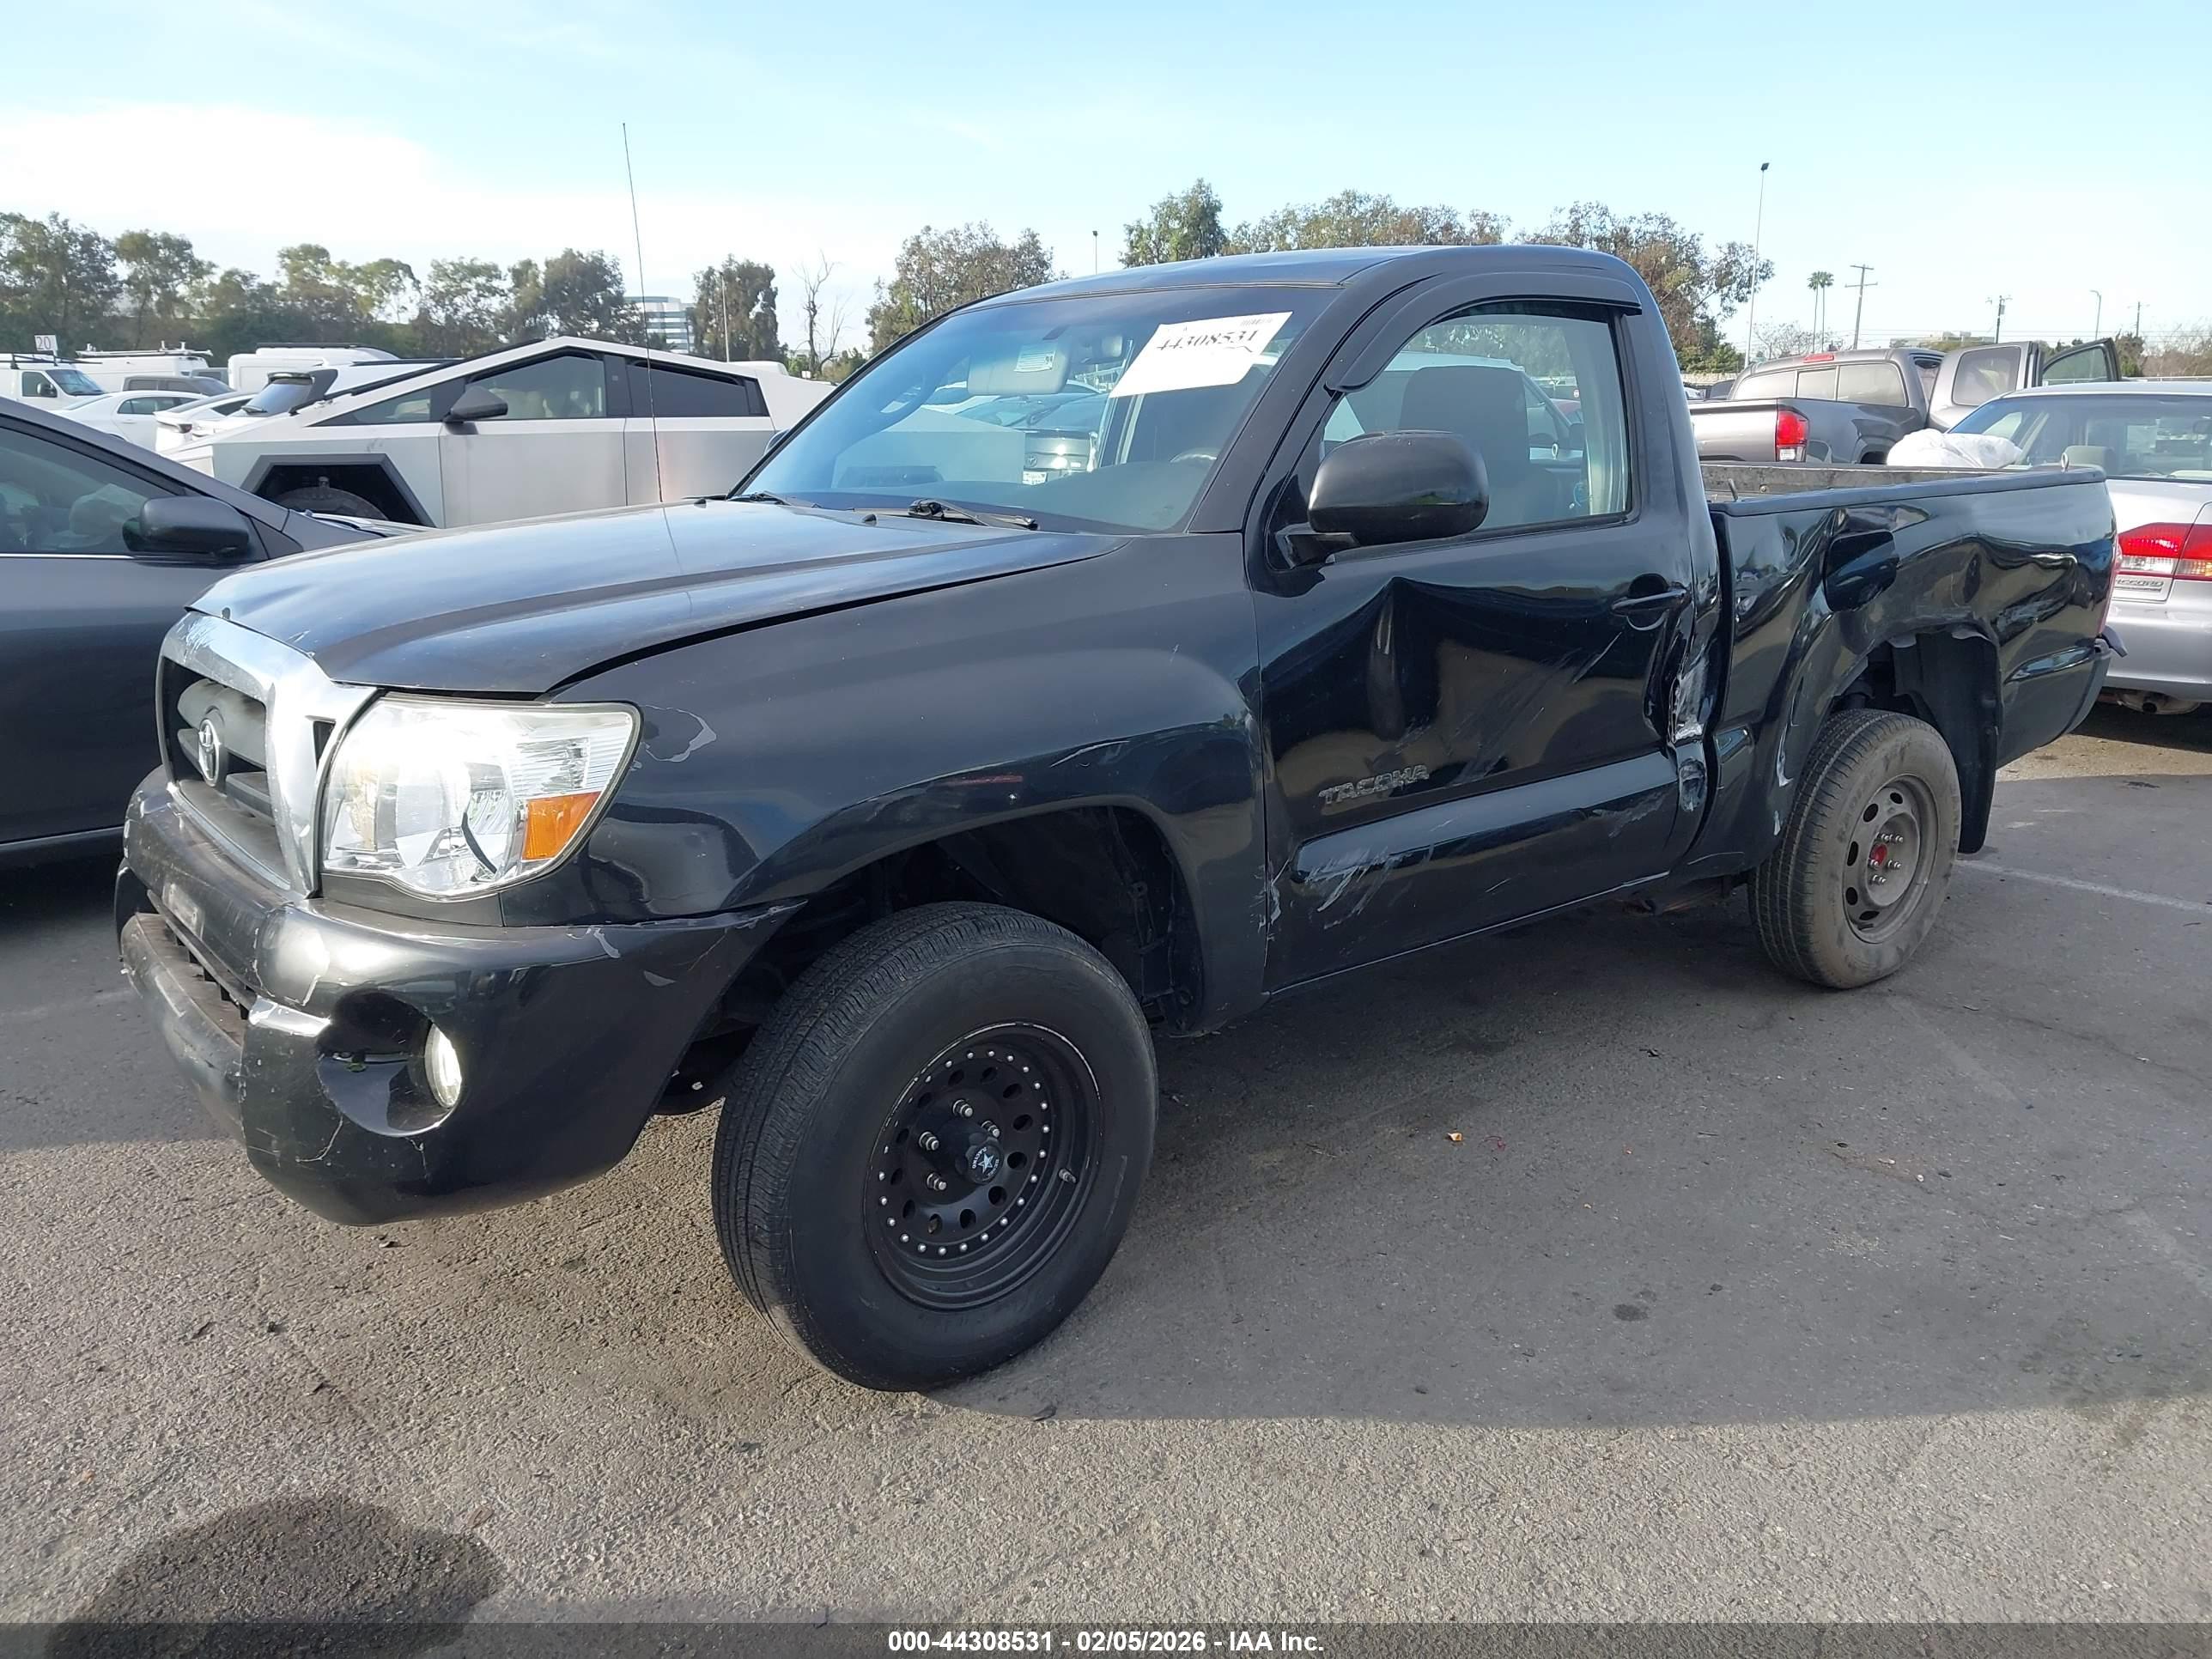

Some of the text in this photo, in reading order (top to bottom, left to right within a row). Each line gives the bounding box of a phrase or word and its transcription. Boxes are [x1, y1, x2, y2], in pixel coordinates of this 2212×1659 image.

[36, 336, 52, 349] 20
[1156, 330, 1258, 350] 44308531
[1318, 764, 1430, 805] TACOMA
